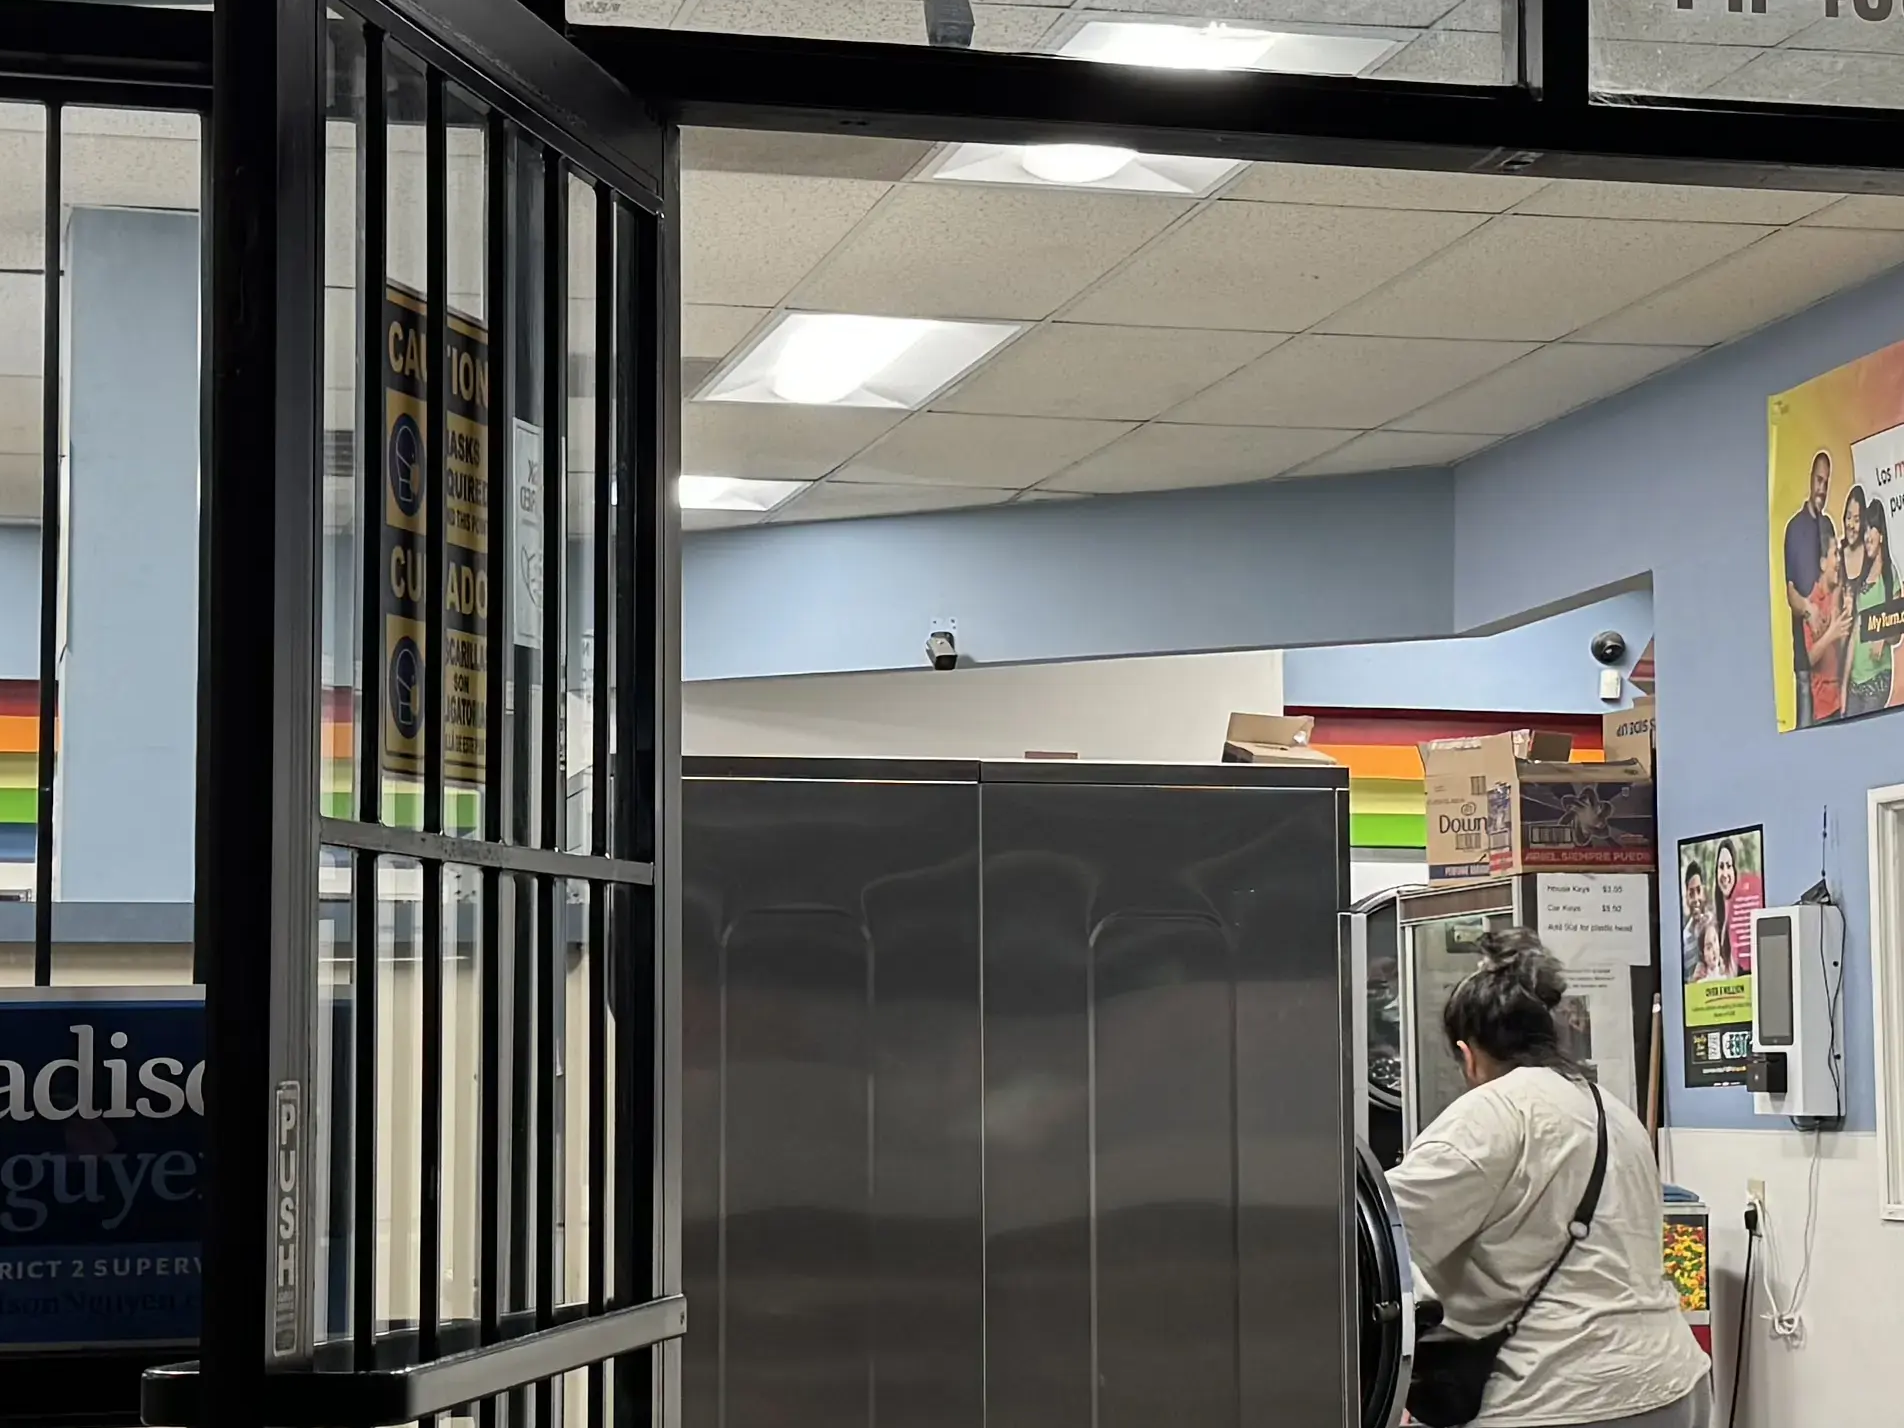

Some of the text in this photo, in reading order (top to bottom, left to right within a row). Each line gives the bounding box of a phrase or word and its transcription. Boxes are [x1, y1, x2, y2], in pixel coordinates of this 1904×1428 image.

[447, 429, 480, 467] ASKS
[1876, 466, 1892, 486] Los
[1439, 815, 1488, 834] Down
[277, 1102, 296, 1287] PUSH
[71, 1260, 85, 1278] 2
